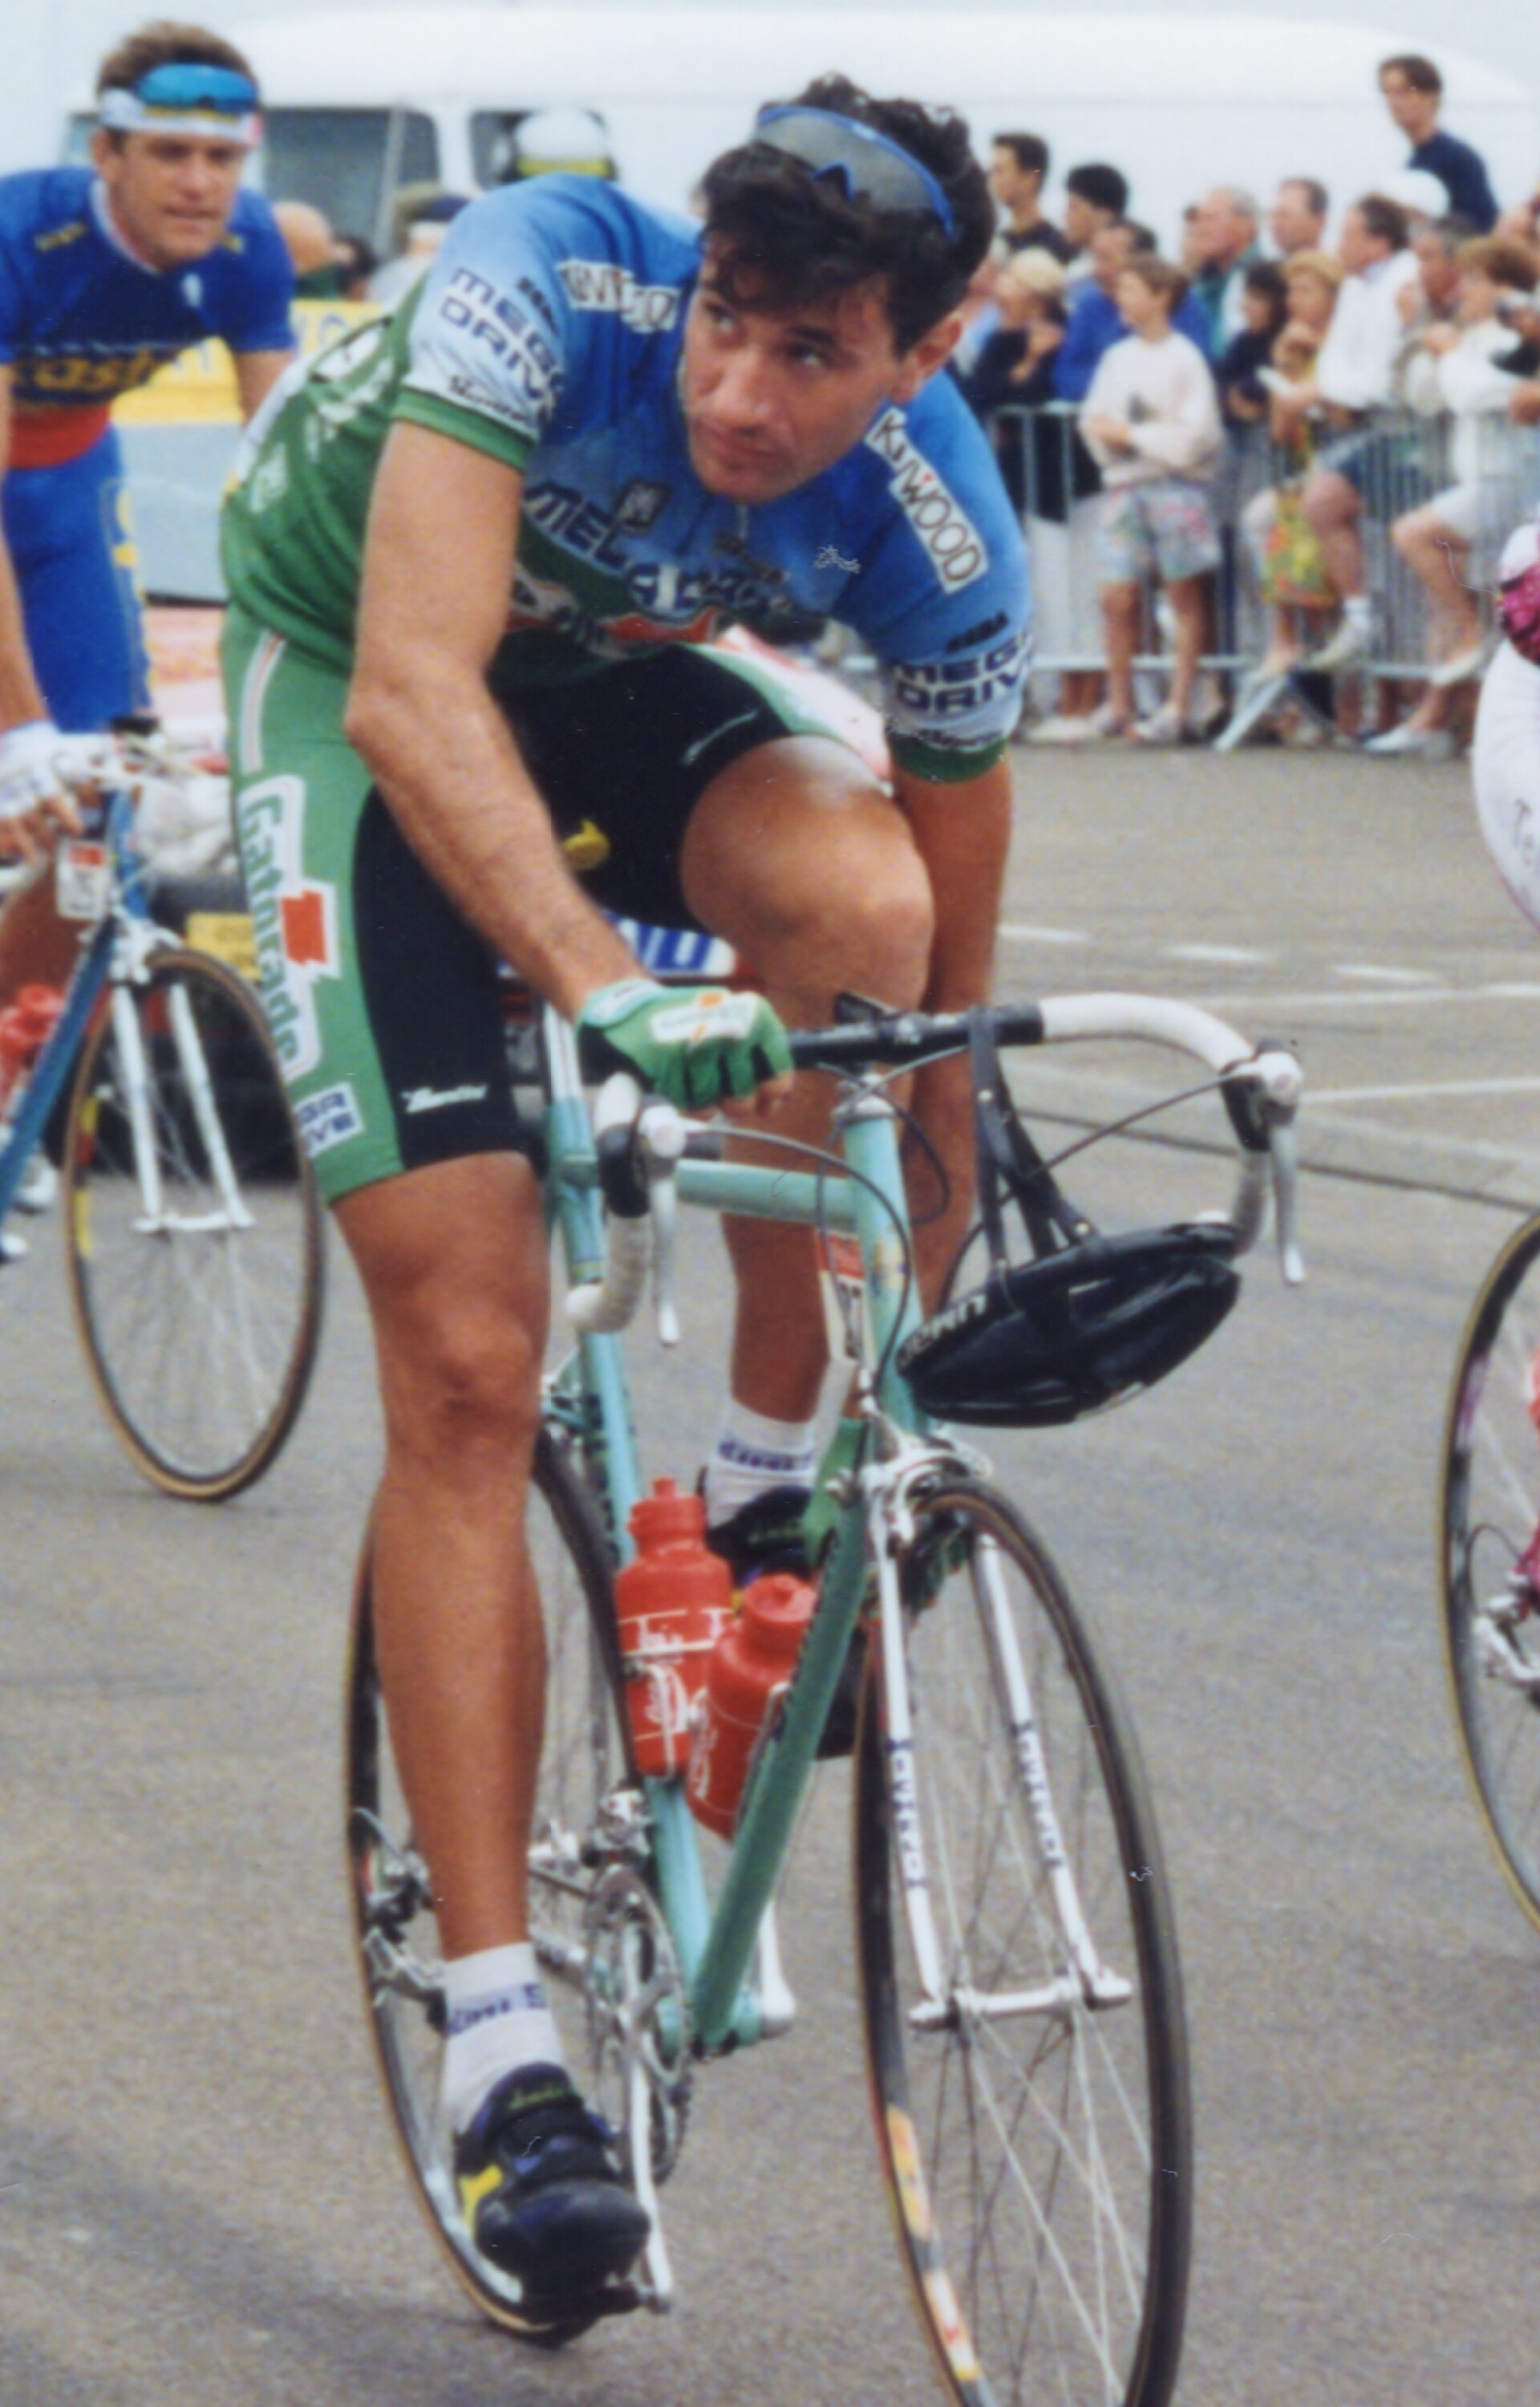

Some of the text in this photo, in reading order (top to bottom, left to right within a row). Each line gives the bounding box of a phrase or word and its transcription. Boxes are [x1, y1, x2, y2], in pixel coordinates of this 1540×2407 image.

[440, 296, 550, 417] DRIV
[892, 631, 1030, 684] MEG
[895, 658, 1027, 712] DRIV
